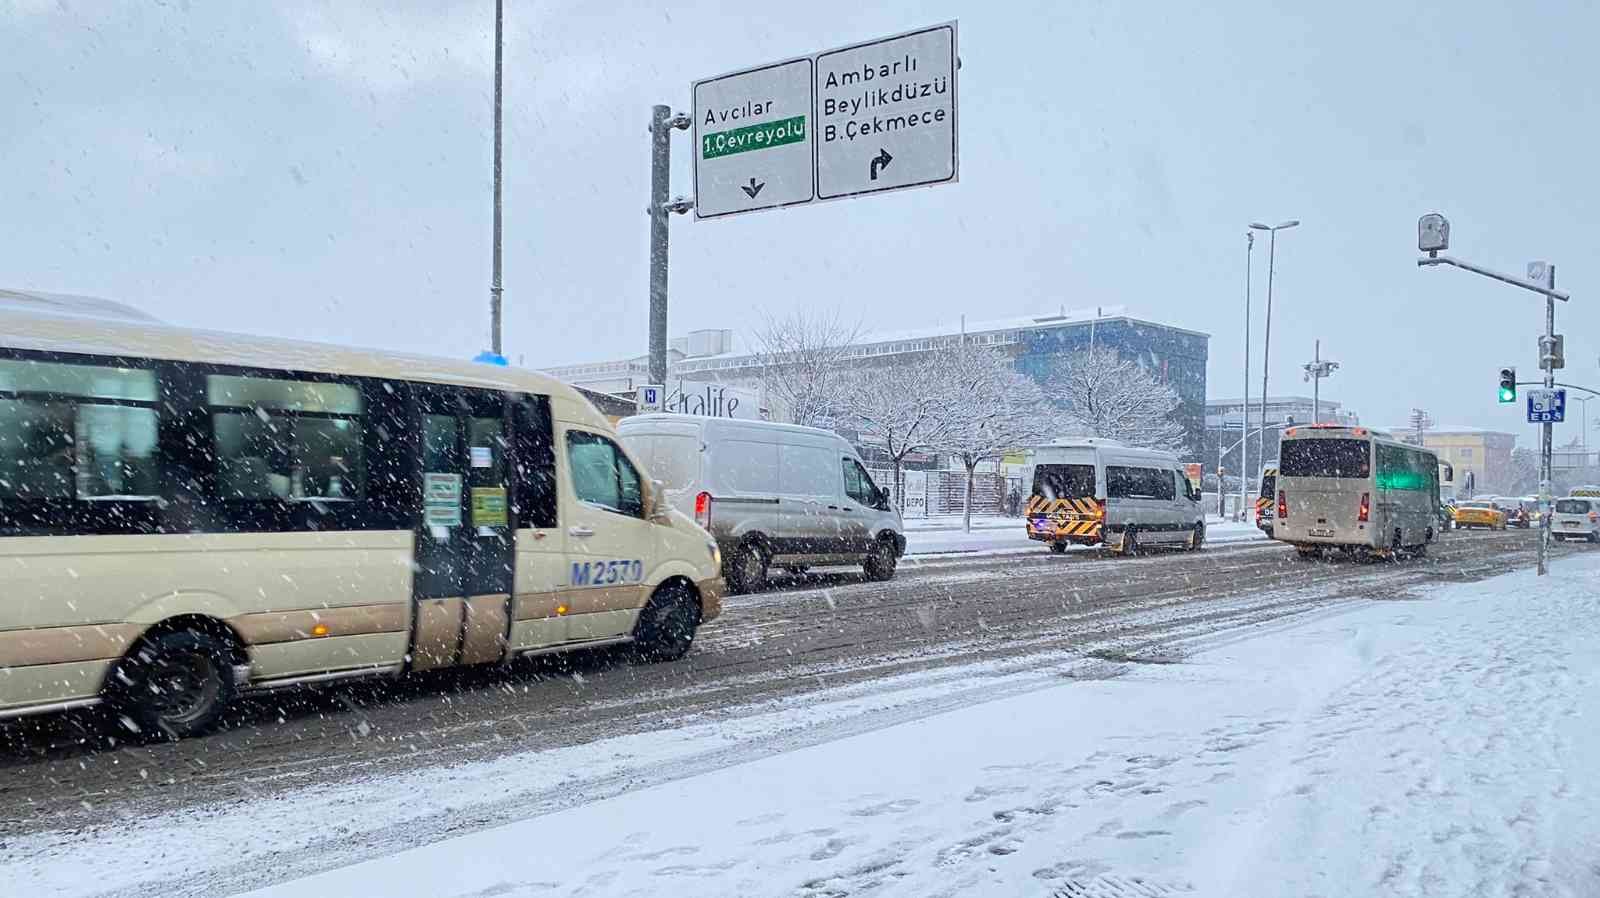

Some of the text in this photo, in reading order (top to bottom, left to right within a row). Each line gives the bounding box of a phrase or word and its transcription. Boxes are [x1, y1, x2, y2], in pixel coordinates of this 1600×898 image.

[825, 54, 917, 89] Ambarlı
[704, 99, 774, 126] Avcılar
[824, 76, 947, 116] Beylikdüzü
[703, 119, 805, 153] 1.Çevreyolu
[824, 108, 946, 143] B.Çekmece
[1530, 412, 1561, 421] EDS
